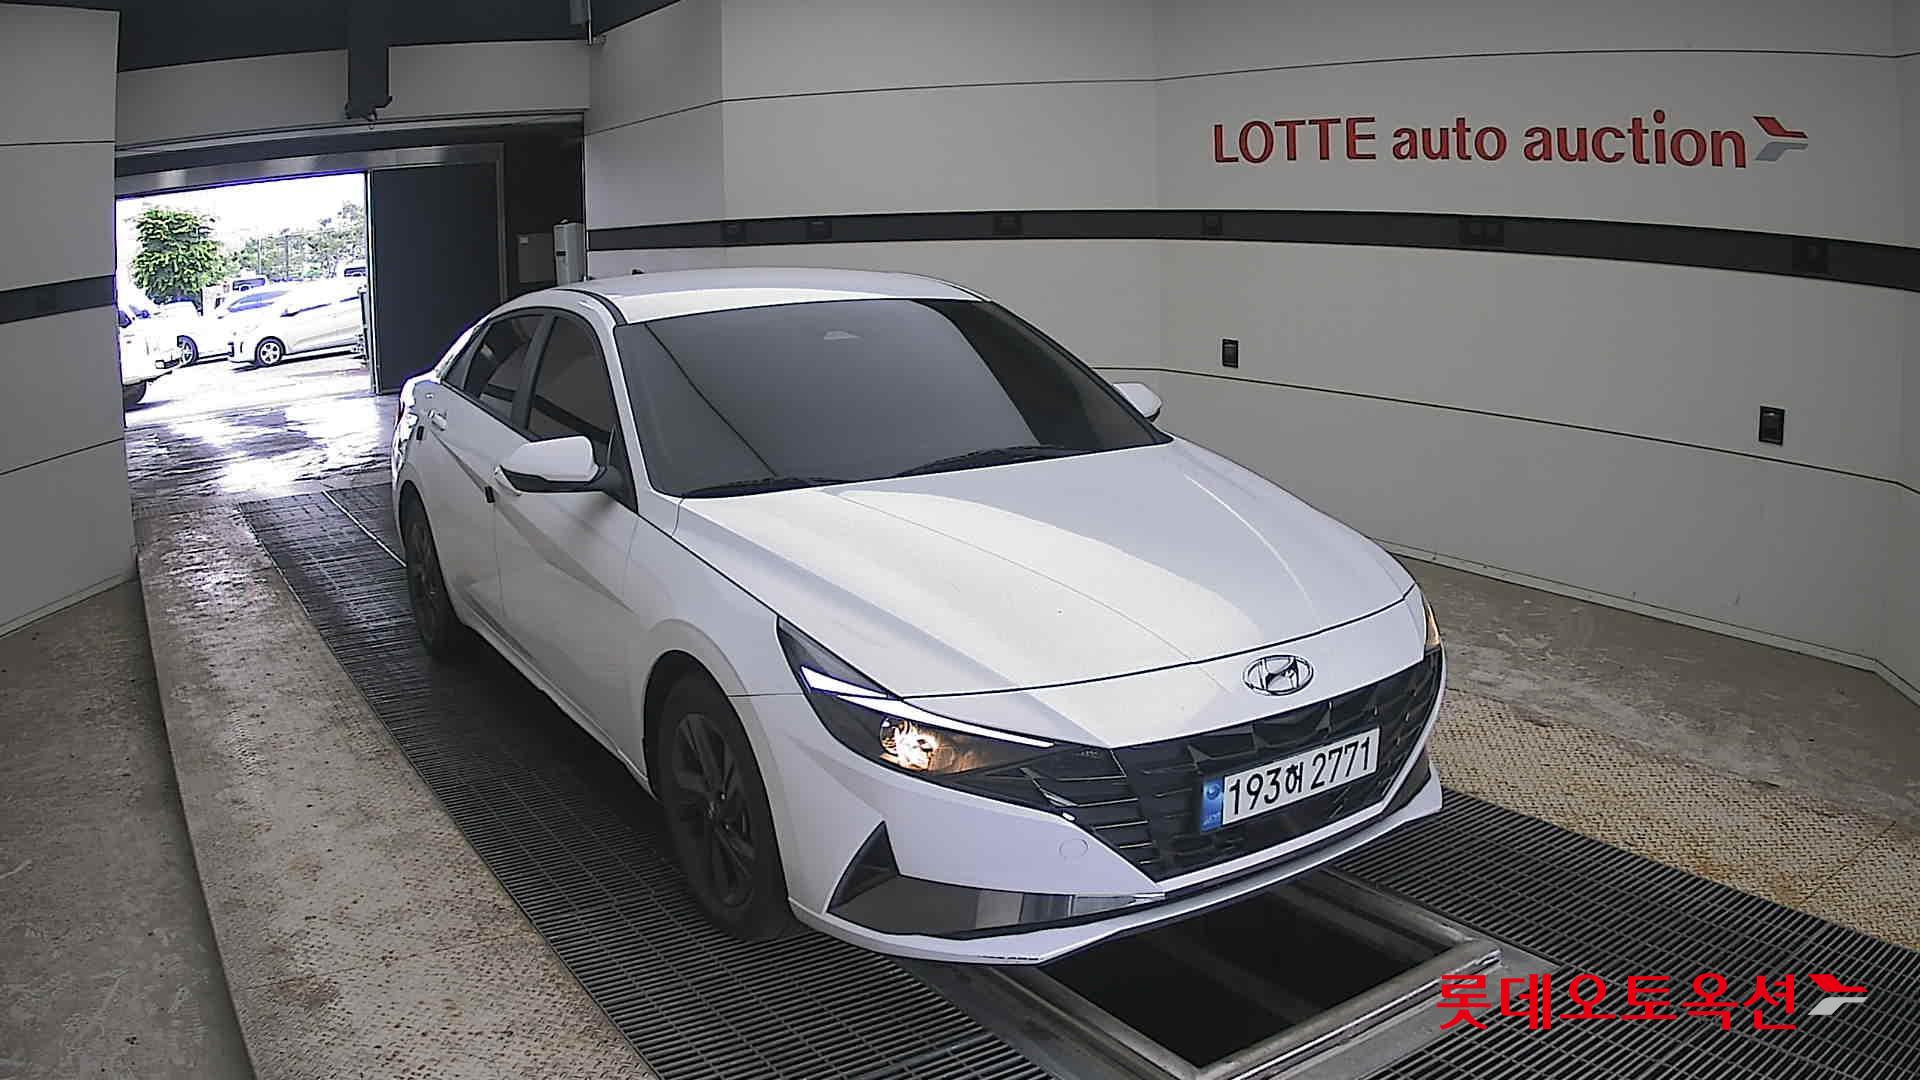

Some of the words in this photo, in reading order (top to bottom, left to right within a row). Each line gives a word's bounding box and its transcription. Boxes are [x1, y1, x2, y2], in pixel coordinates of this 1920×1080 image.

[1213, 116, 1377, 164] LOTTE
[1391, 116, 1509, 162] auto
[1522, 108, 1747, 168] auction
[1229, 761, 1305, 816] 193허
[1310, 735, 1371, 791] 2771
